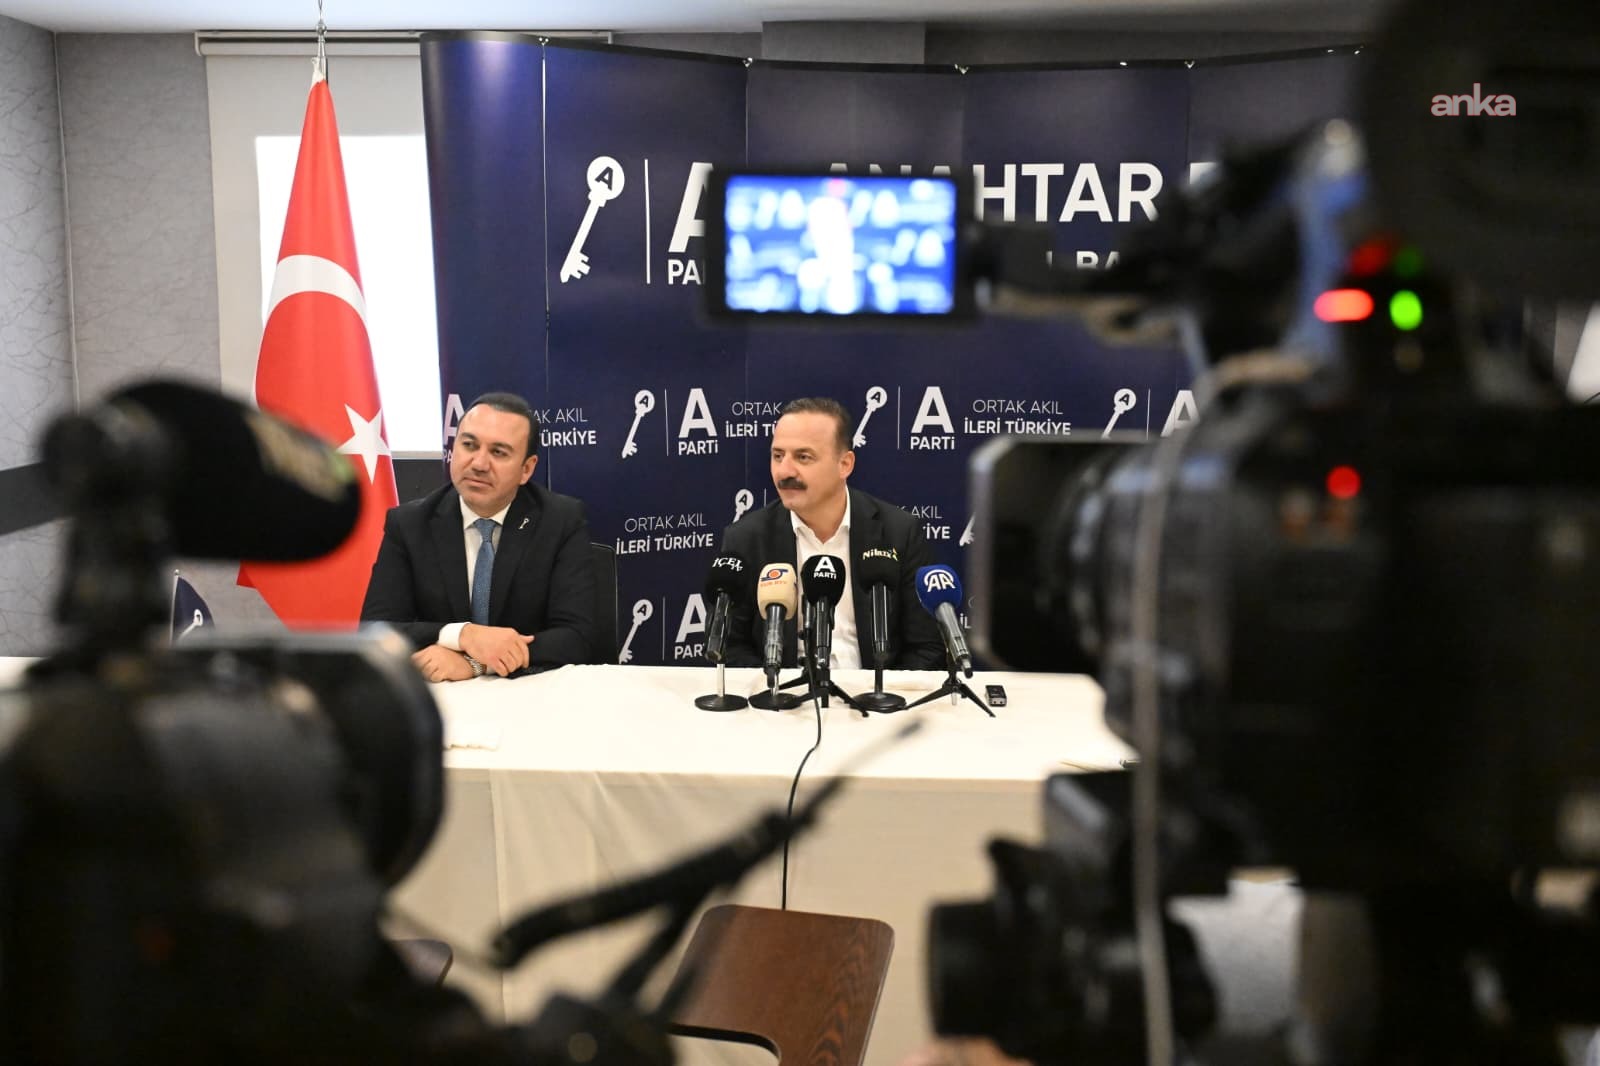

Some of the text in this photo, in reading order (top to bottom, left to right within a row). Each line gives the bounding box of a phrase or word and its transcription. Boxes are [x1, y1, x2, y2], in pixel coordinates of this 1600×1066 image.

[555, 408, 588, 423] AKIL
[678, 388, 718, 438] A
[731, 402, 783, 416] ORTAK
[911, 386, 955, 433] A
[972, 400, 1064, 415] ORTAK AKIL
[725, 420, 758, 438] İLERİ
[964, 416, 1072, 436] İLERİ TÜRKİYE
[539, 427, 597, 447] ÜRKİYE
[911, 506, 943, 519] AKIL
[624, 513, 707, 533] ORTAK AKIL
[616, 531, 714, 555] İLERİ TÜRKİYE
[814, 556, 837, 572] A
[925, 571, 956, 593] AA
[674, 643, 705, 660] PAR
